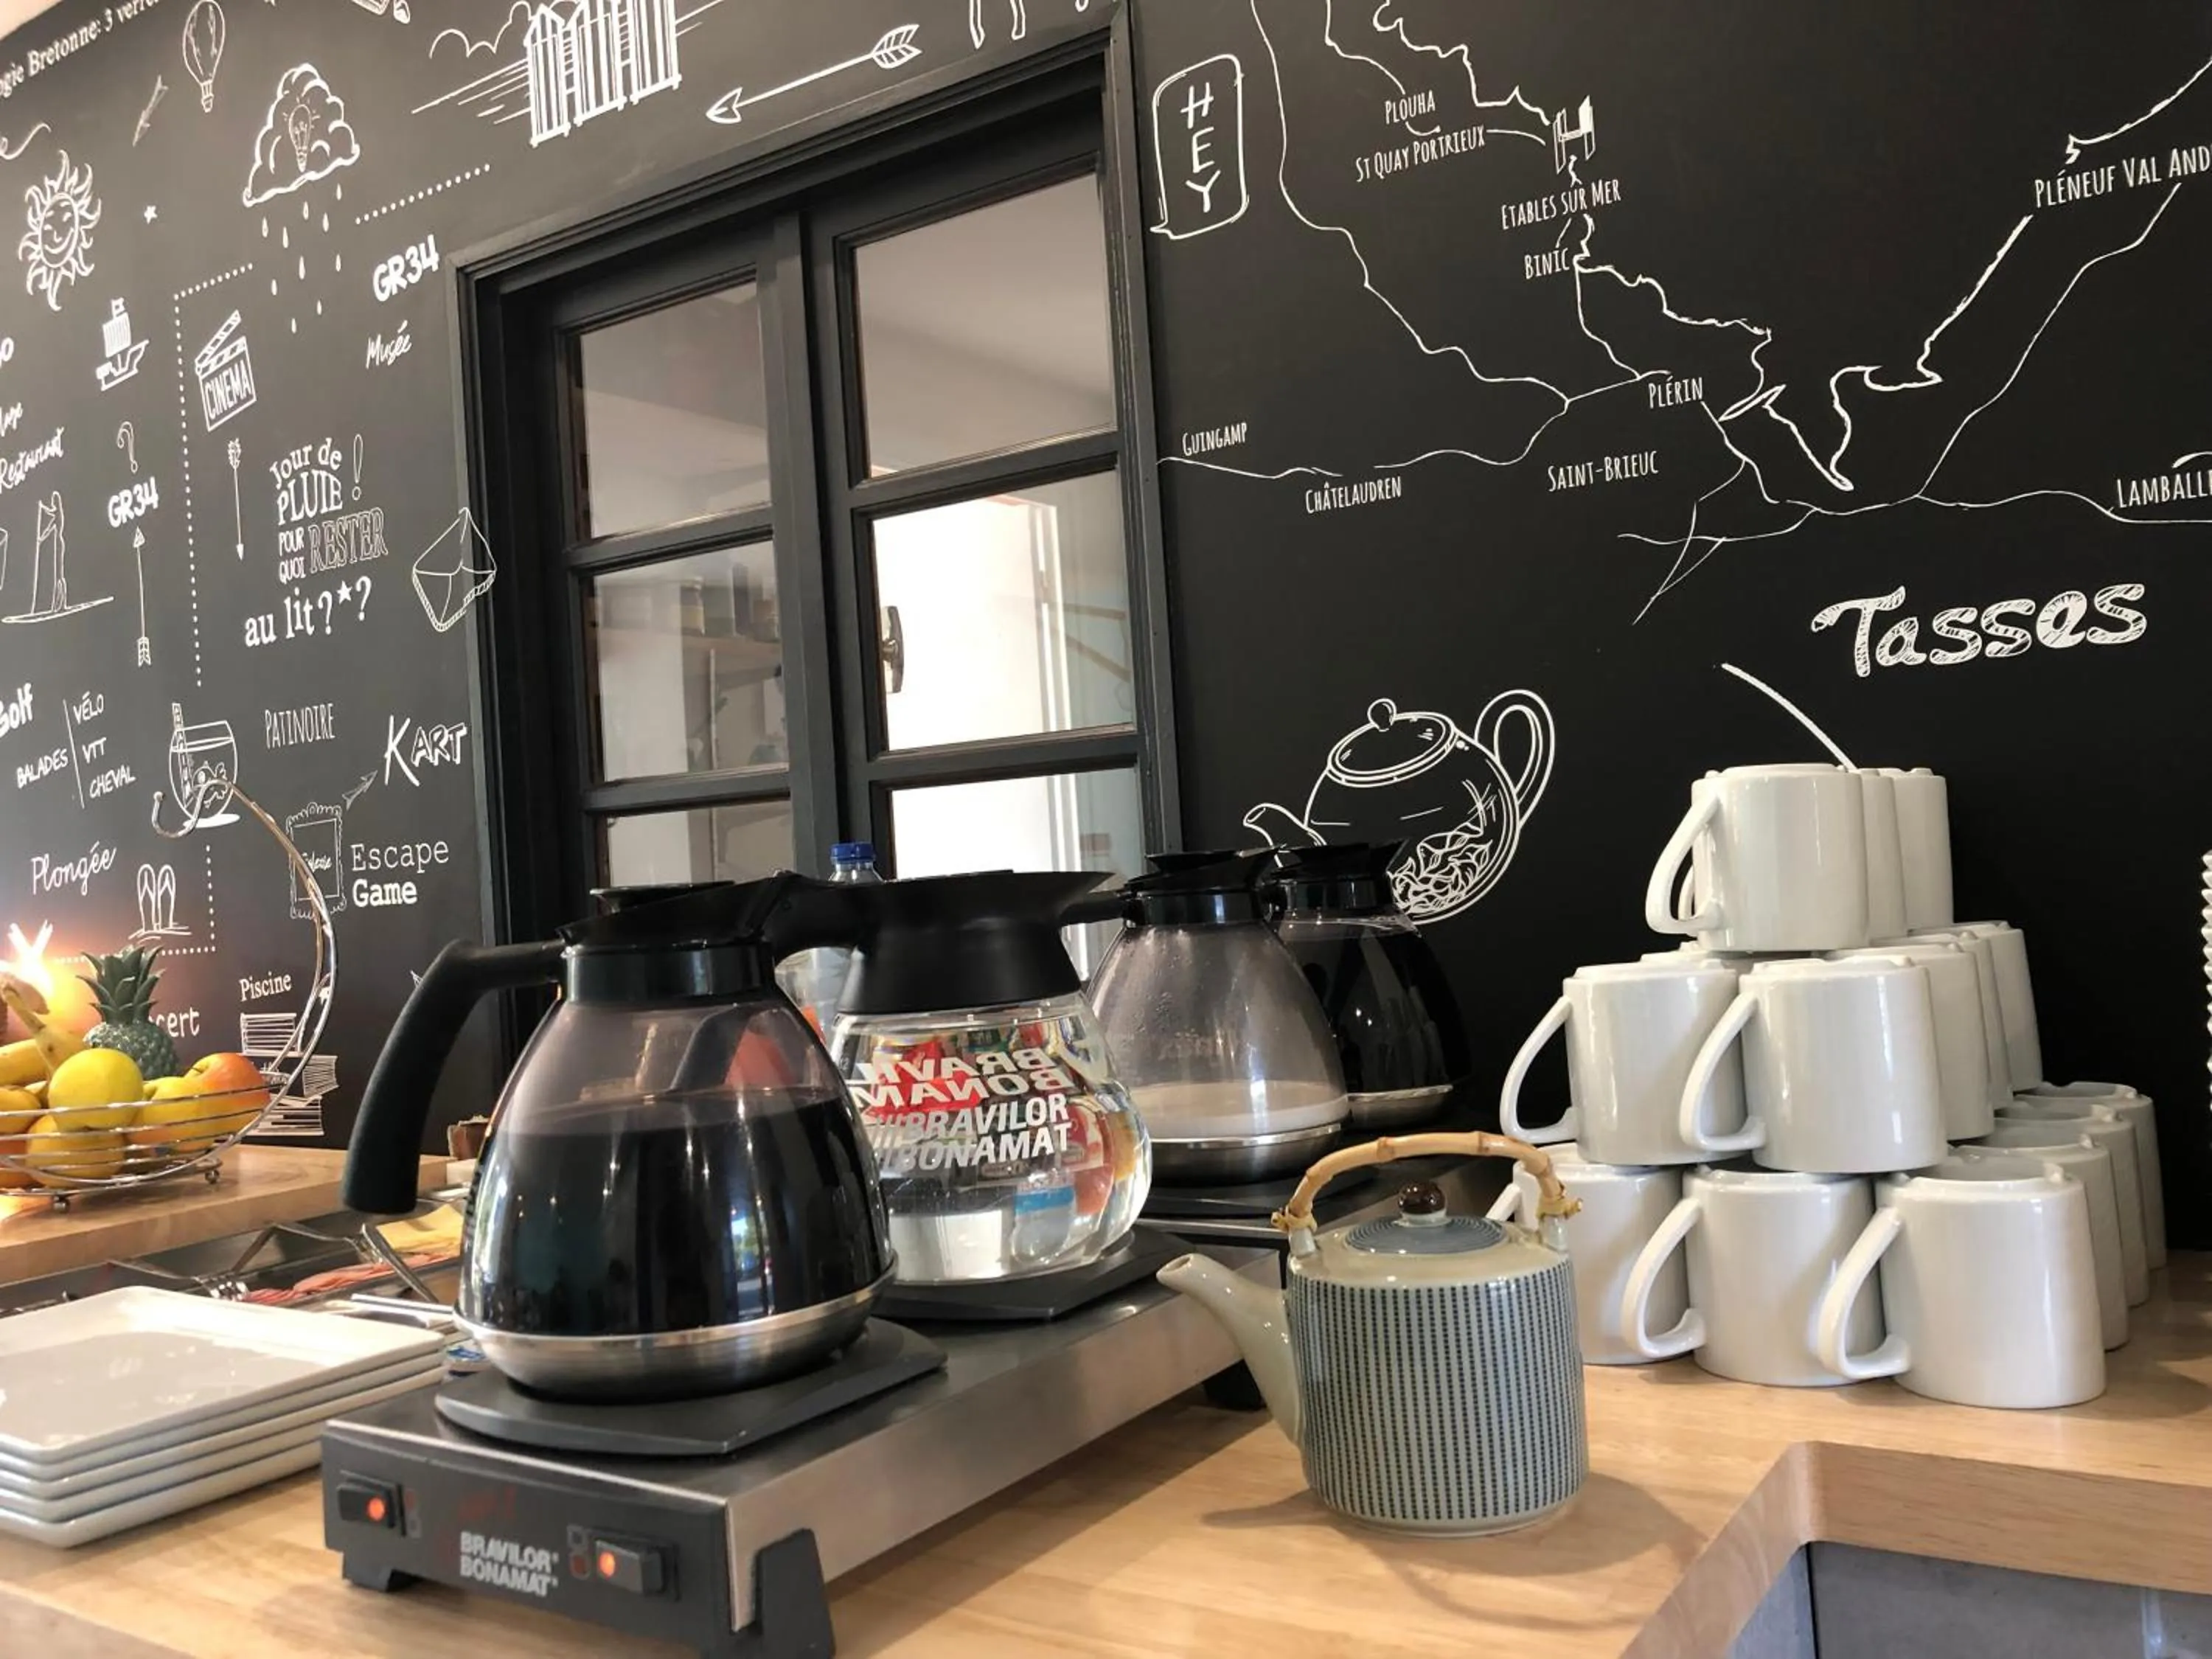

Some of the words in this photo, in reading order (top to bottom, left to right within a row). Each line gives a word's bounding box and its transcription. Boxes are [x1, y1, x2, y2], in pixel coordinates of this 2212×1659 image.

[27, 20, 101, 77] Bretonne:
[104, 7, 113, 32] 3
[116, 0, 159, 23] verr
[1384, 89, 1436, 125] PLOUHA
[1180, 82, 1221, 212] HEY
[1374, 147, 1410, 179] QUAY
[1413, 125, 1485, 165] PORTRIEUX
[2034, 169, 2115, 209] PLÉNEUF
[2122, 156, 2162, 188] VAL
[2168, 145, 2212, 179] AND
[1501, 195, 1557, 230] ETABLES
[1561, 187, 1587, 215] SUR
[1592, 179, 1621, 207] MER
[373, 234, 439, 302] GR34
[1524, 248, 1570, 280] BINIC
[205, 359, 251, 420] CINEMA
[1648, 375, 1703, 409] PLÉRIN
[318, 438, 341, 470] de
[1182, 422, 1248, 456] GUINGAMP
[1548, 451, 1658, 493] SAINT-BRIEUC
[108, 476, 159, 528] GR34
[277, 469, 342, 525] PLUIE
[279, 527, 304, 556] POUR
[309, 507, 388, 574] RESTER
[279, 557, 306, 584] QUOI
[244, 613, 276, 647] au
[1811, 583, 2147, 678] Tasses
[74, 691, 104, 724] VÉLO
[265, 703, 335, 749] PATINOIRE
[16, 748, 69, 789] BALADES
[82, 737, 107, 763] VTT
[384, 714, 467, 786] KART
[89, 765, 136, 799] CHEVAL
[30, 841, 116, 896] Plongée
[351, 840, 450, 874] Escape
[352, 879, 417, 907] Game
[239, 971, 292, 1001] Piscine
[903, 1093, 1069, 1142] BRAVILOR
[895, 1121, 1073, 1173] BONAMAT
